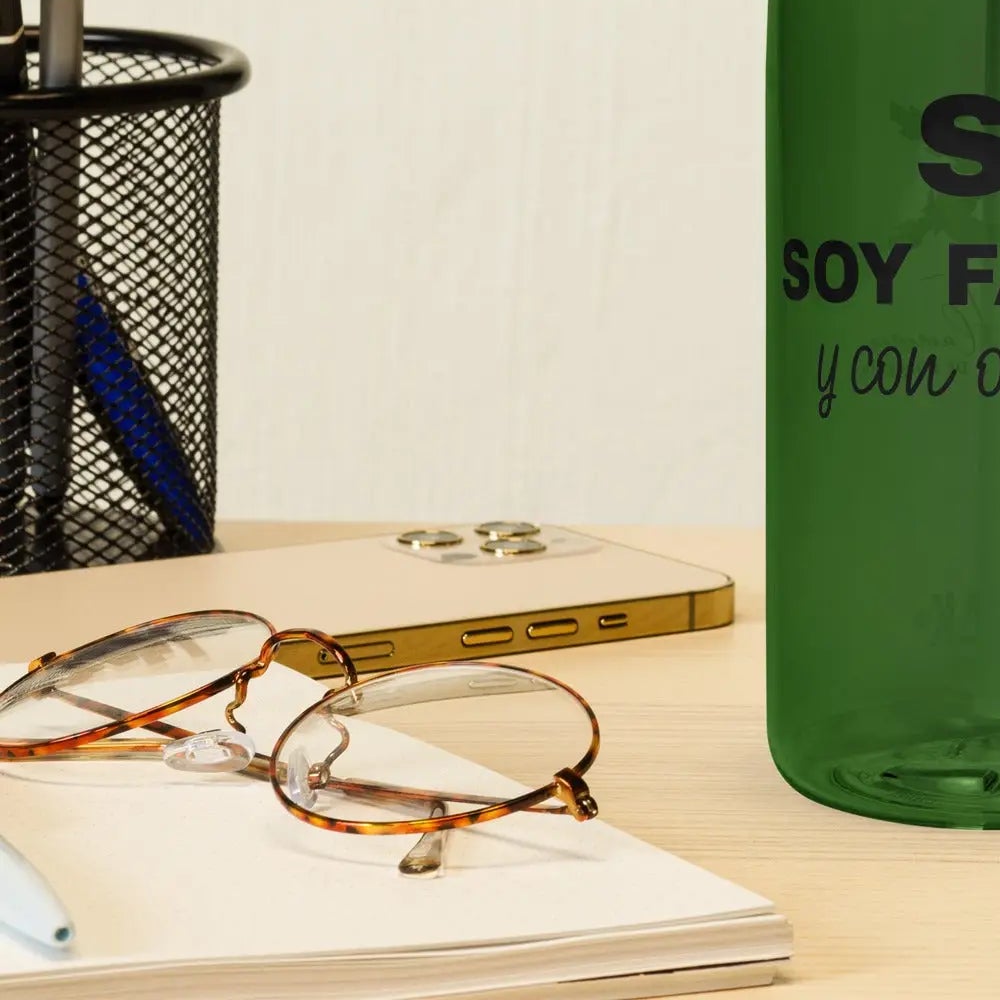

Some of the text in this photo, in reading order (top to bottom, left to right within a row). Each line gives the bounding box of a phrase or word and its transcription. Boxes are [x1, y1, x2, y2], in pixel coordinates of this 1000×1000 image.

[782, 238, 913, 305] SOY
[817, 343, 840, 419] y
[850, 344, 958, 397] con
